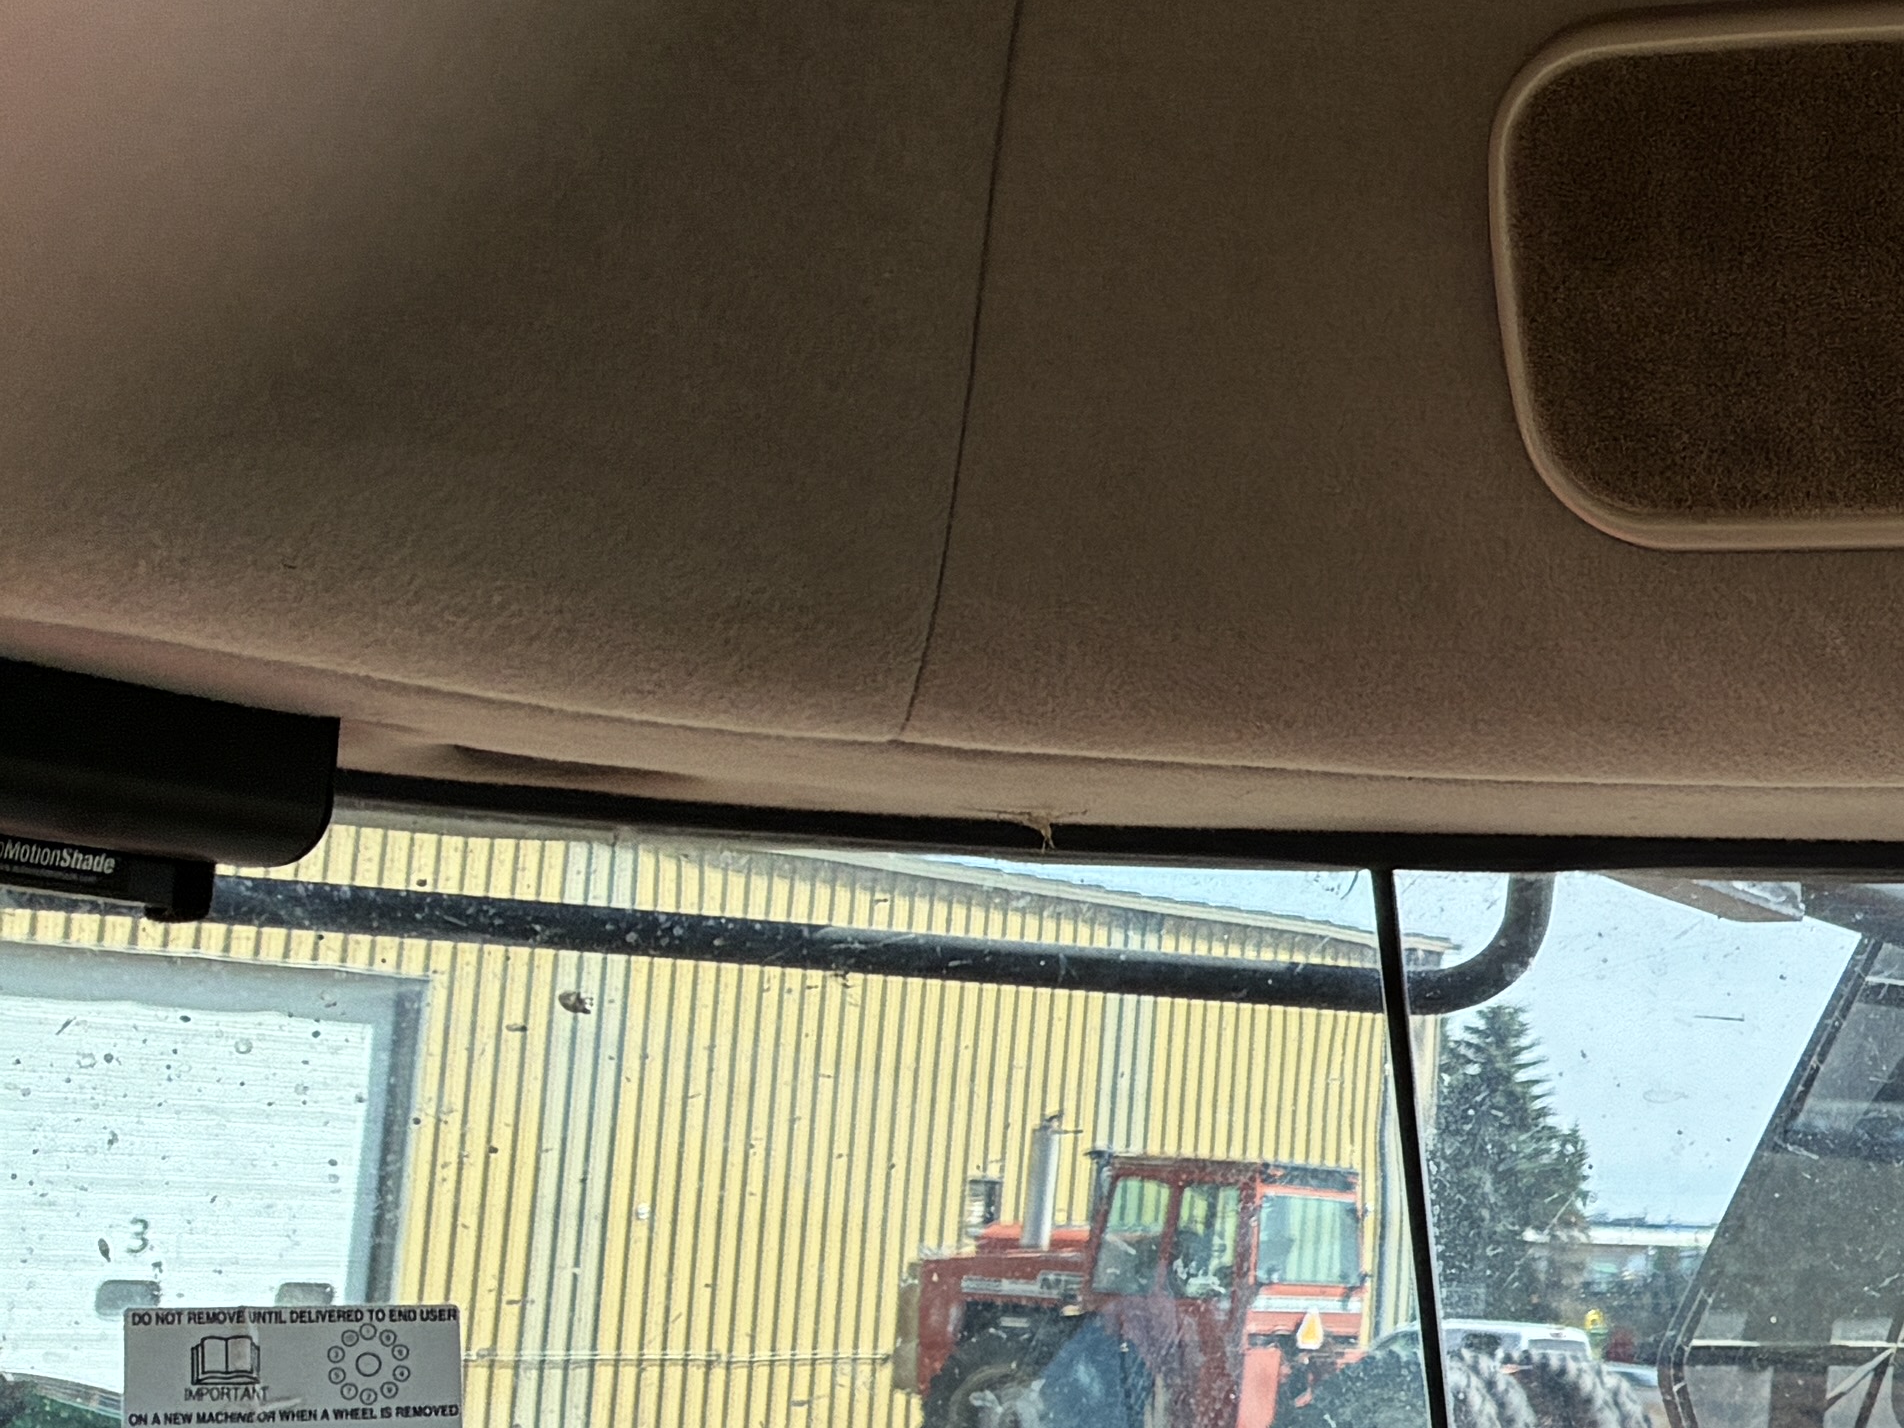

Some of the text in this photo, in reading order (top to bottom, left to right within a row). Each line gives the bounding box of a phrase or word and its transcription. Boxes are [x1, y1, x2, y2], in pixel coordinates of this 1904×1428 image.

[132, 1308, 457, 1326] DO NOT REMOVE UNTIL DELIVERED TO END USER
[184, 1385, 269, 1402] IMPORTANT
[128, 1404, 459, 1426] ON A NEW MACHINE OR WHEN A WHEEL IS REMOVED
